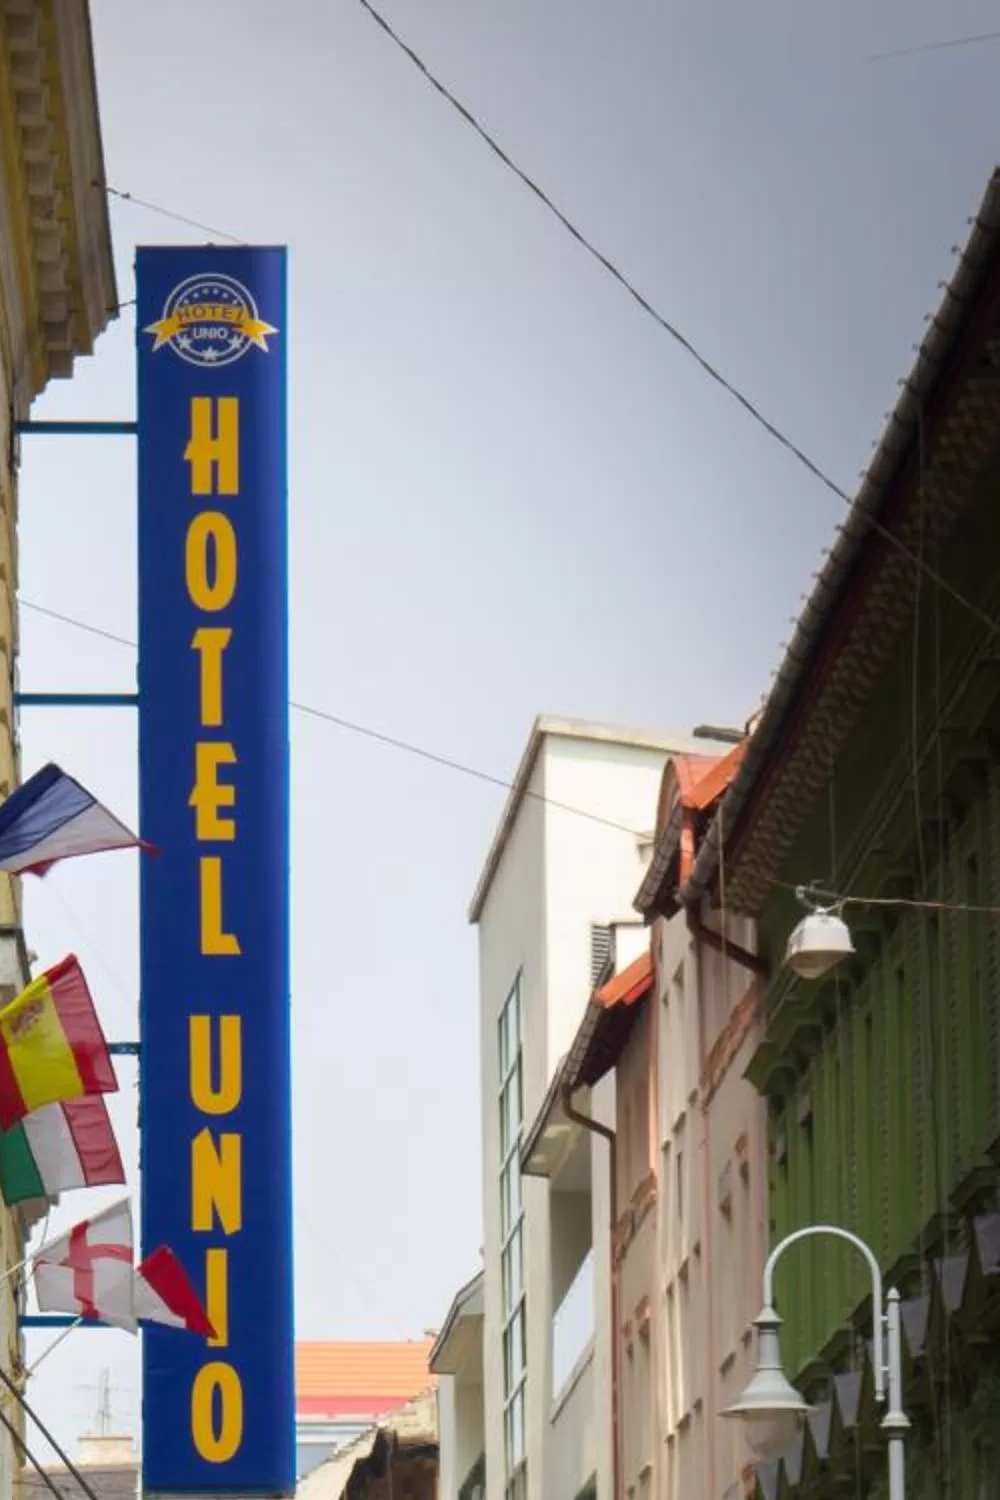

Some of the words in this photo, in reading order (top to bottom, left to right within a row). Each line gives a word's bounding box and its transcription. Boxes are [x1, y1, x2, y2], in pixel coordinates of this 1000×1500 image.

[177, 304, 247, 322] HOTEL
[184, 396, 242, 956] HOTEL
[189, 1014, 243, 1464] UNIO
